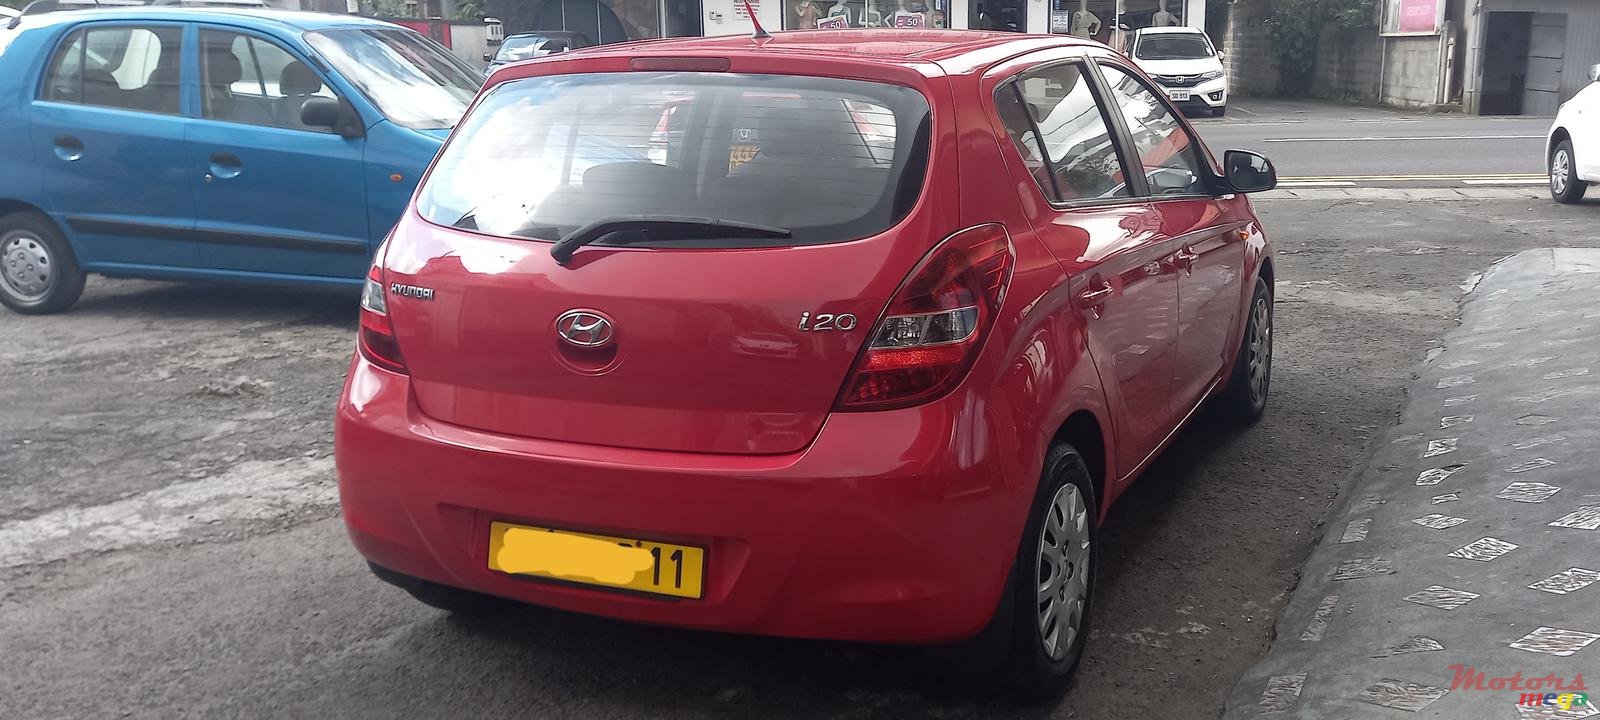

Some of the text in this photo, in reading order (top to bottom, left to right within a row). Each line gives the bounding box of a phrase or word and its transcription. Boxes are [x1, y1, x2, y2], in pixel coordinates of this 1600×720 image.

[391, 283, 434, 299] HYUNDAI
[798, 311, 857, 331] i20
[651, 547, 683, 588] 11
